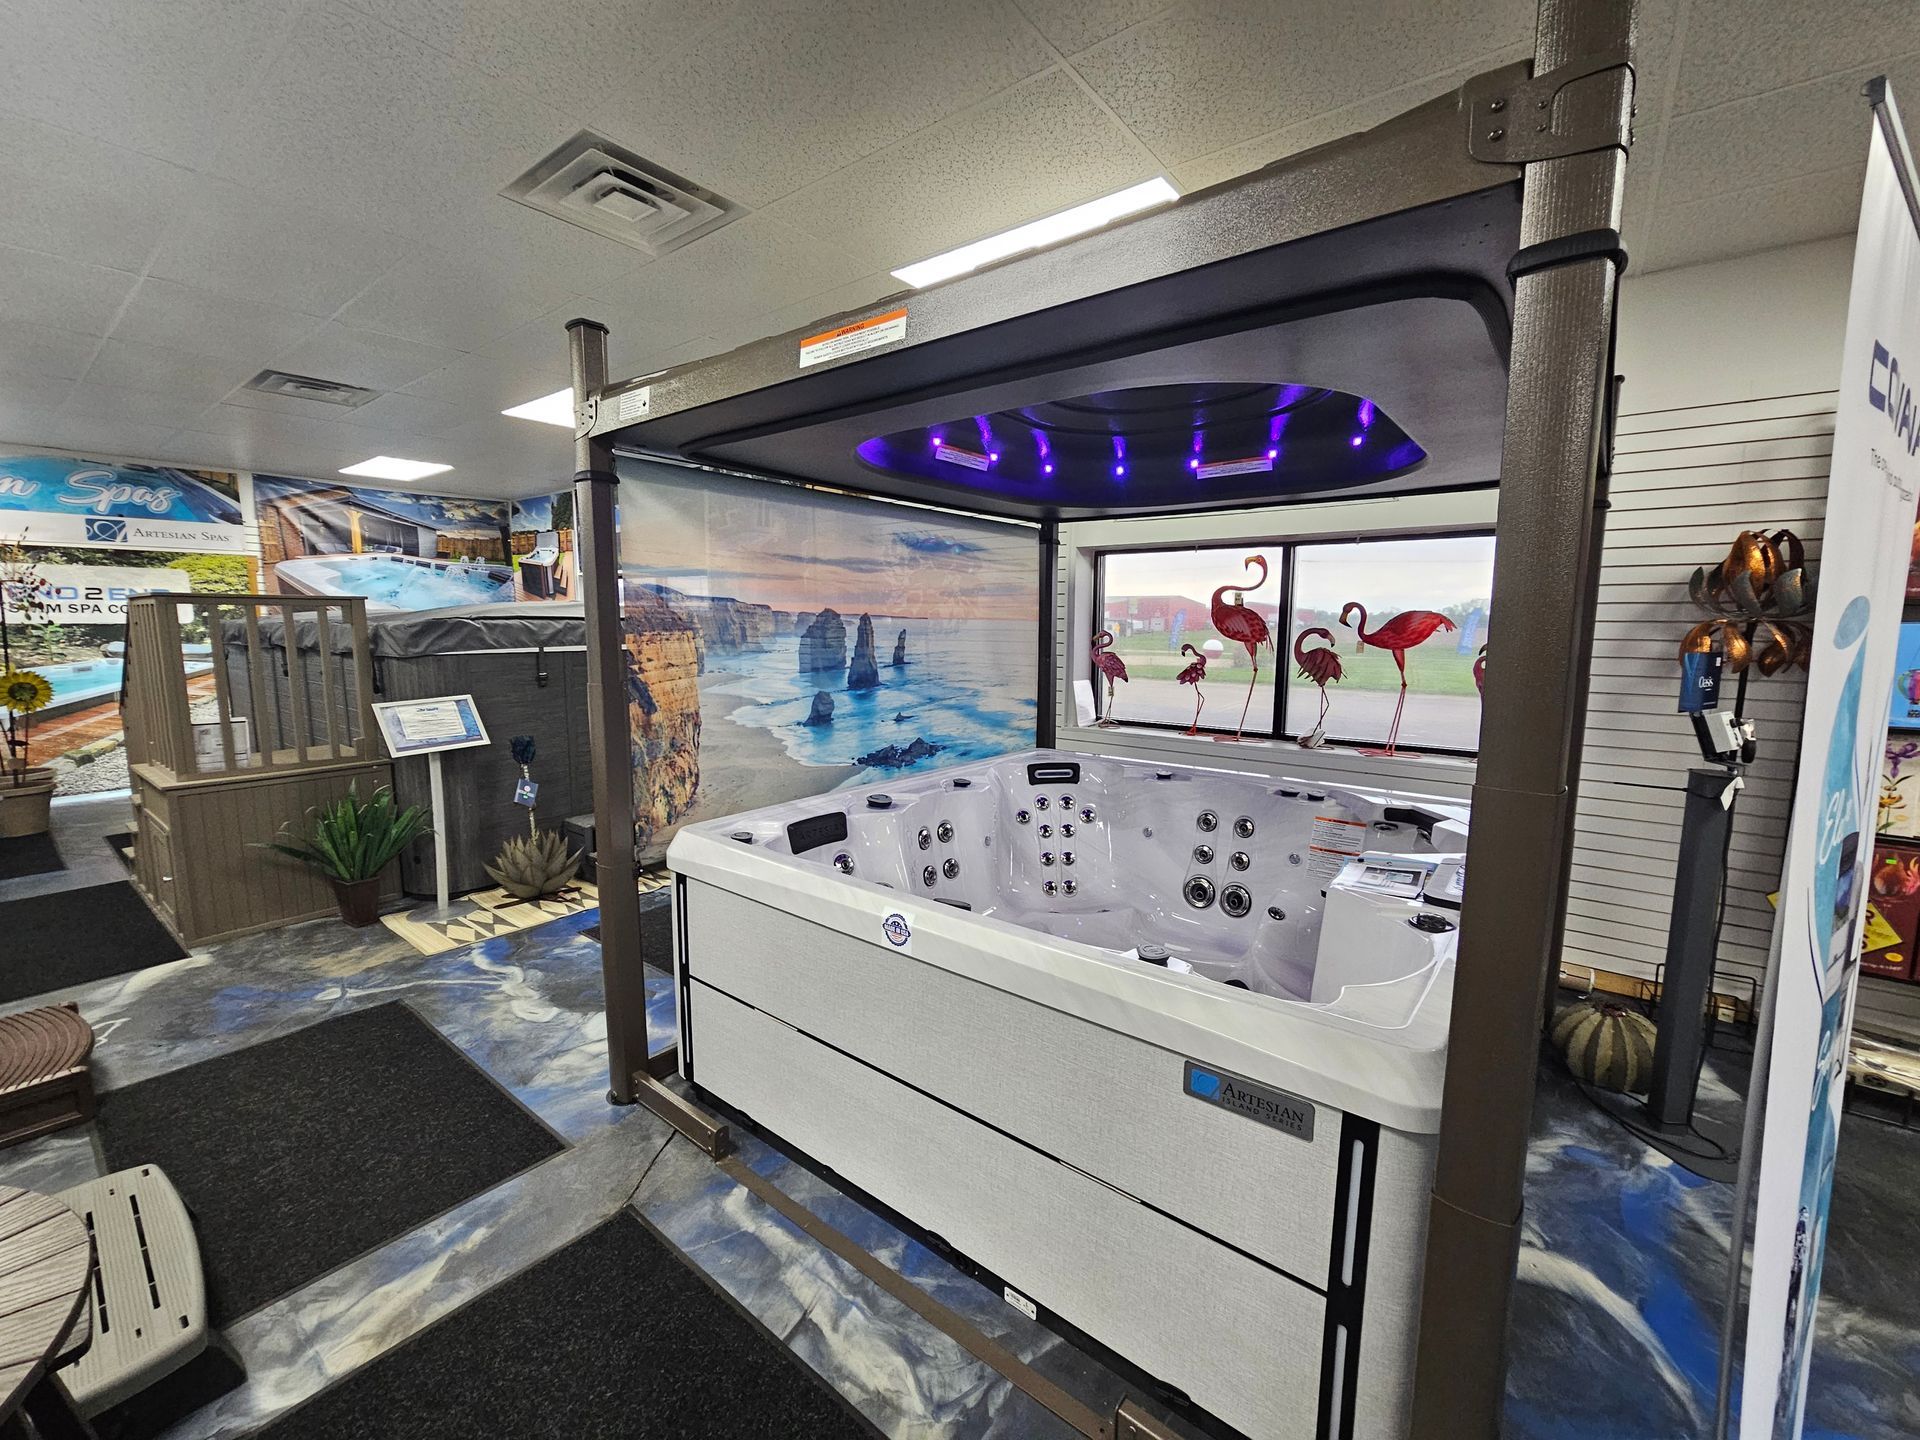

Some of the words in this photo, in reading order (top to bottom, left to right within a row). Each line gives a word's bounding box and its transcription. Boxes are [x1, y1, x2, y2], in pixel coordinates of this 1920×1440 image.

[841, 323, 865, 335] WARNING
[58, 470, 181, 513] Spas
[133, 527, 196, 540] ARTESIAN
[202, 531, 229, 542] SPAS
[85, 587, 104, 601] 2
[8, 604, 62, 614] SM
[68, 604, 103, 614] SPA
[1222, 1083, 1304, 1123] ARTESIAN
[1222, 1097, 1260, 1115] ISLAND
[1266, 1113, 1302, 1131] SERIES
